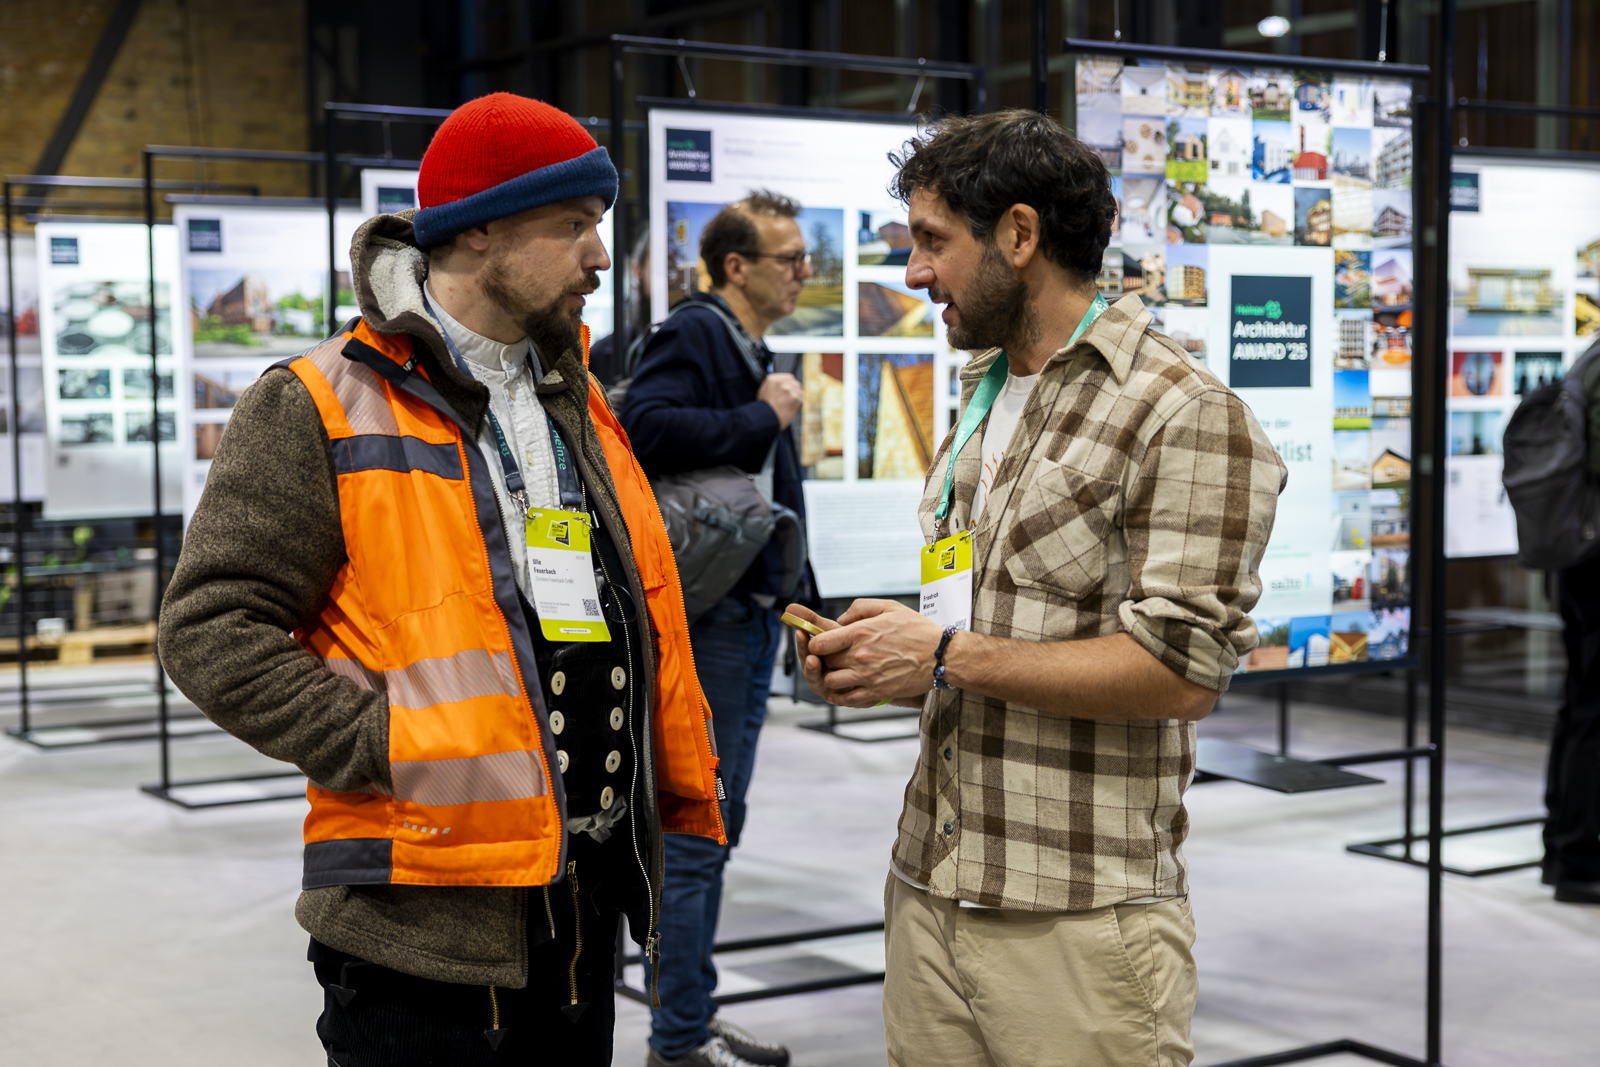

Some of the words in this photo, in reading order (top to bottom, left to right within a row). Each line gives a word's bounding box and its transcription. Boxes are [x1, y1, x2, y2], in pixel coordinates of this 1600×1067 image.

[1232, 320, 1308, 338] Architektur
[1232, 342, 1287, 360] AWARD
[1274, 418, 1291, 429] der
[534, 567, 556, 575] Feuerbach
